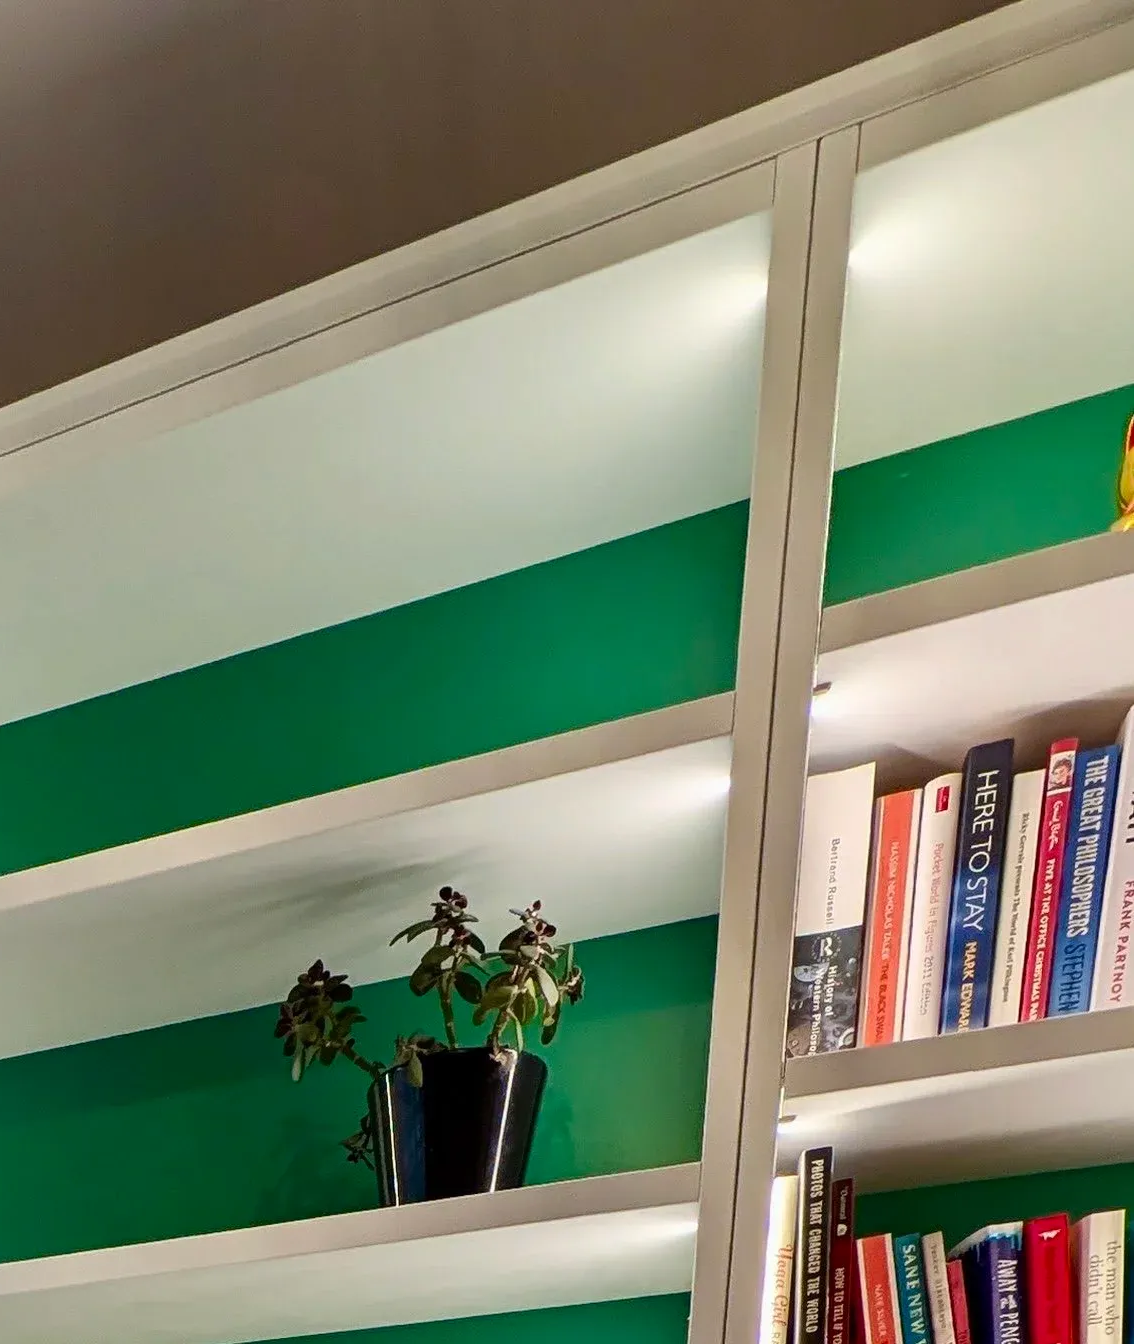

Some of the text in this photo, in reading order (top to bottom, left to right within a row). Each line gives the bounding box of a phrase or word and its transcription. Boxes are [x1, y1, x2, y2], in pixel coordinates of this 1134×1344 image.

[963, 770, 998, 930] HERE TO STAY
[826, 886, 836, 924] Russell
[1059, 756, 1108, 1010] THE GREAT PHILOSOPHERS STEPHEN
[1009, 897, 1020, 944] The World of
[1031, 859, 1055, 1000] FIVE AT THE OFFICE CHRISTMAS
[1111, 881, 1134, 1001] FRANK PARTNOY
[877, 880, 895, 1013] NICHOLAS THE BLACK
[963, 942, 976, 979] MARK
[813, 968, 824, 1010] Western
[823, 965, 837, 1015] History of
[806, 1159, 824, 1332] PHOTOS THAT CHANGED THE WORLD
[903, 1245, 919, 1289] SANE
[834, 1292, 843, 1301] TO
[835, 1267, 844, 1288] HOW
[997, 1260, 1017, 1292] AWAY
[1086, 1255, 1103, 1326] didn't call
[1105, 1240, 1121, 1335] the man who
[833, 1304, 843, 1320] TELL
[908, 1294, 923, 1333] NEW
